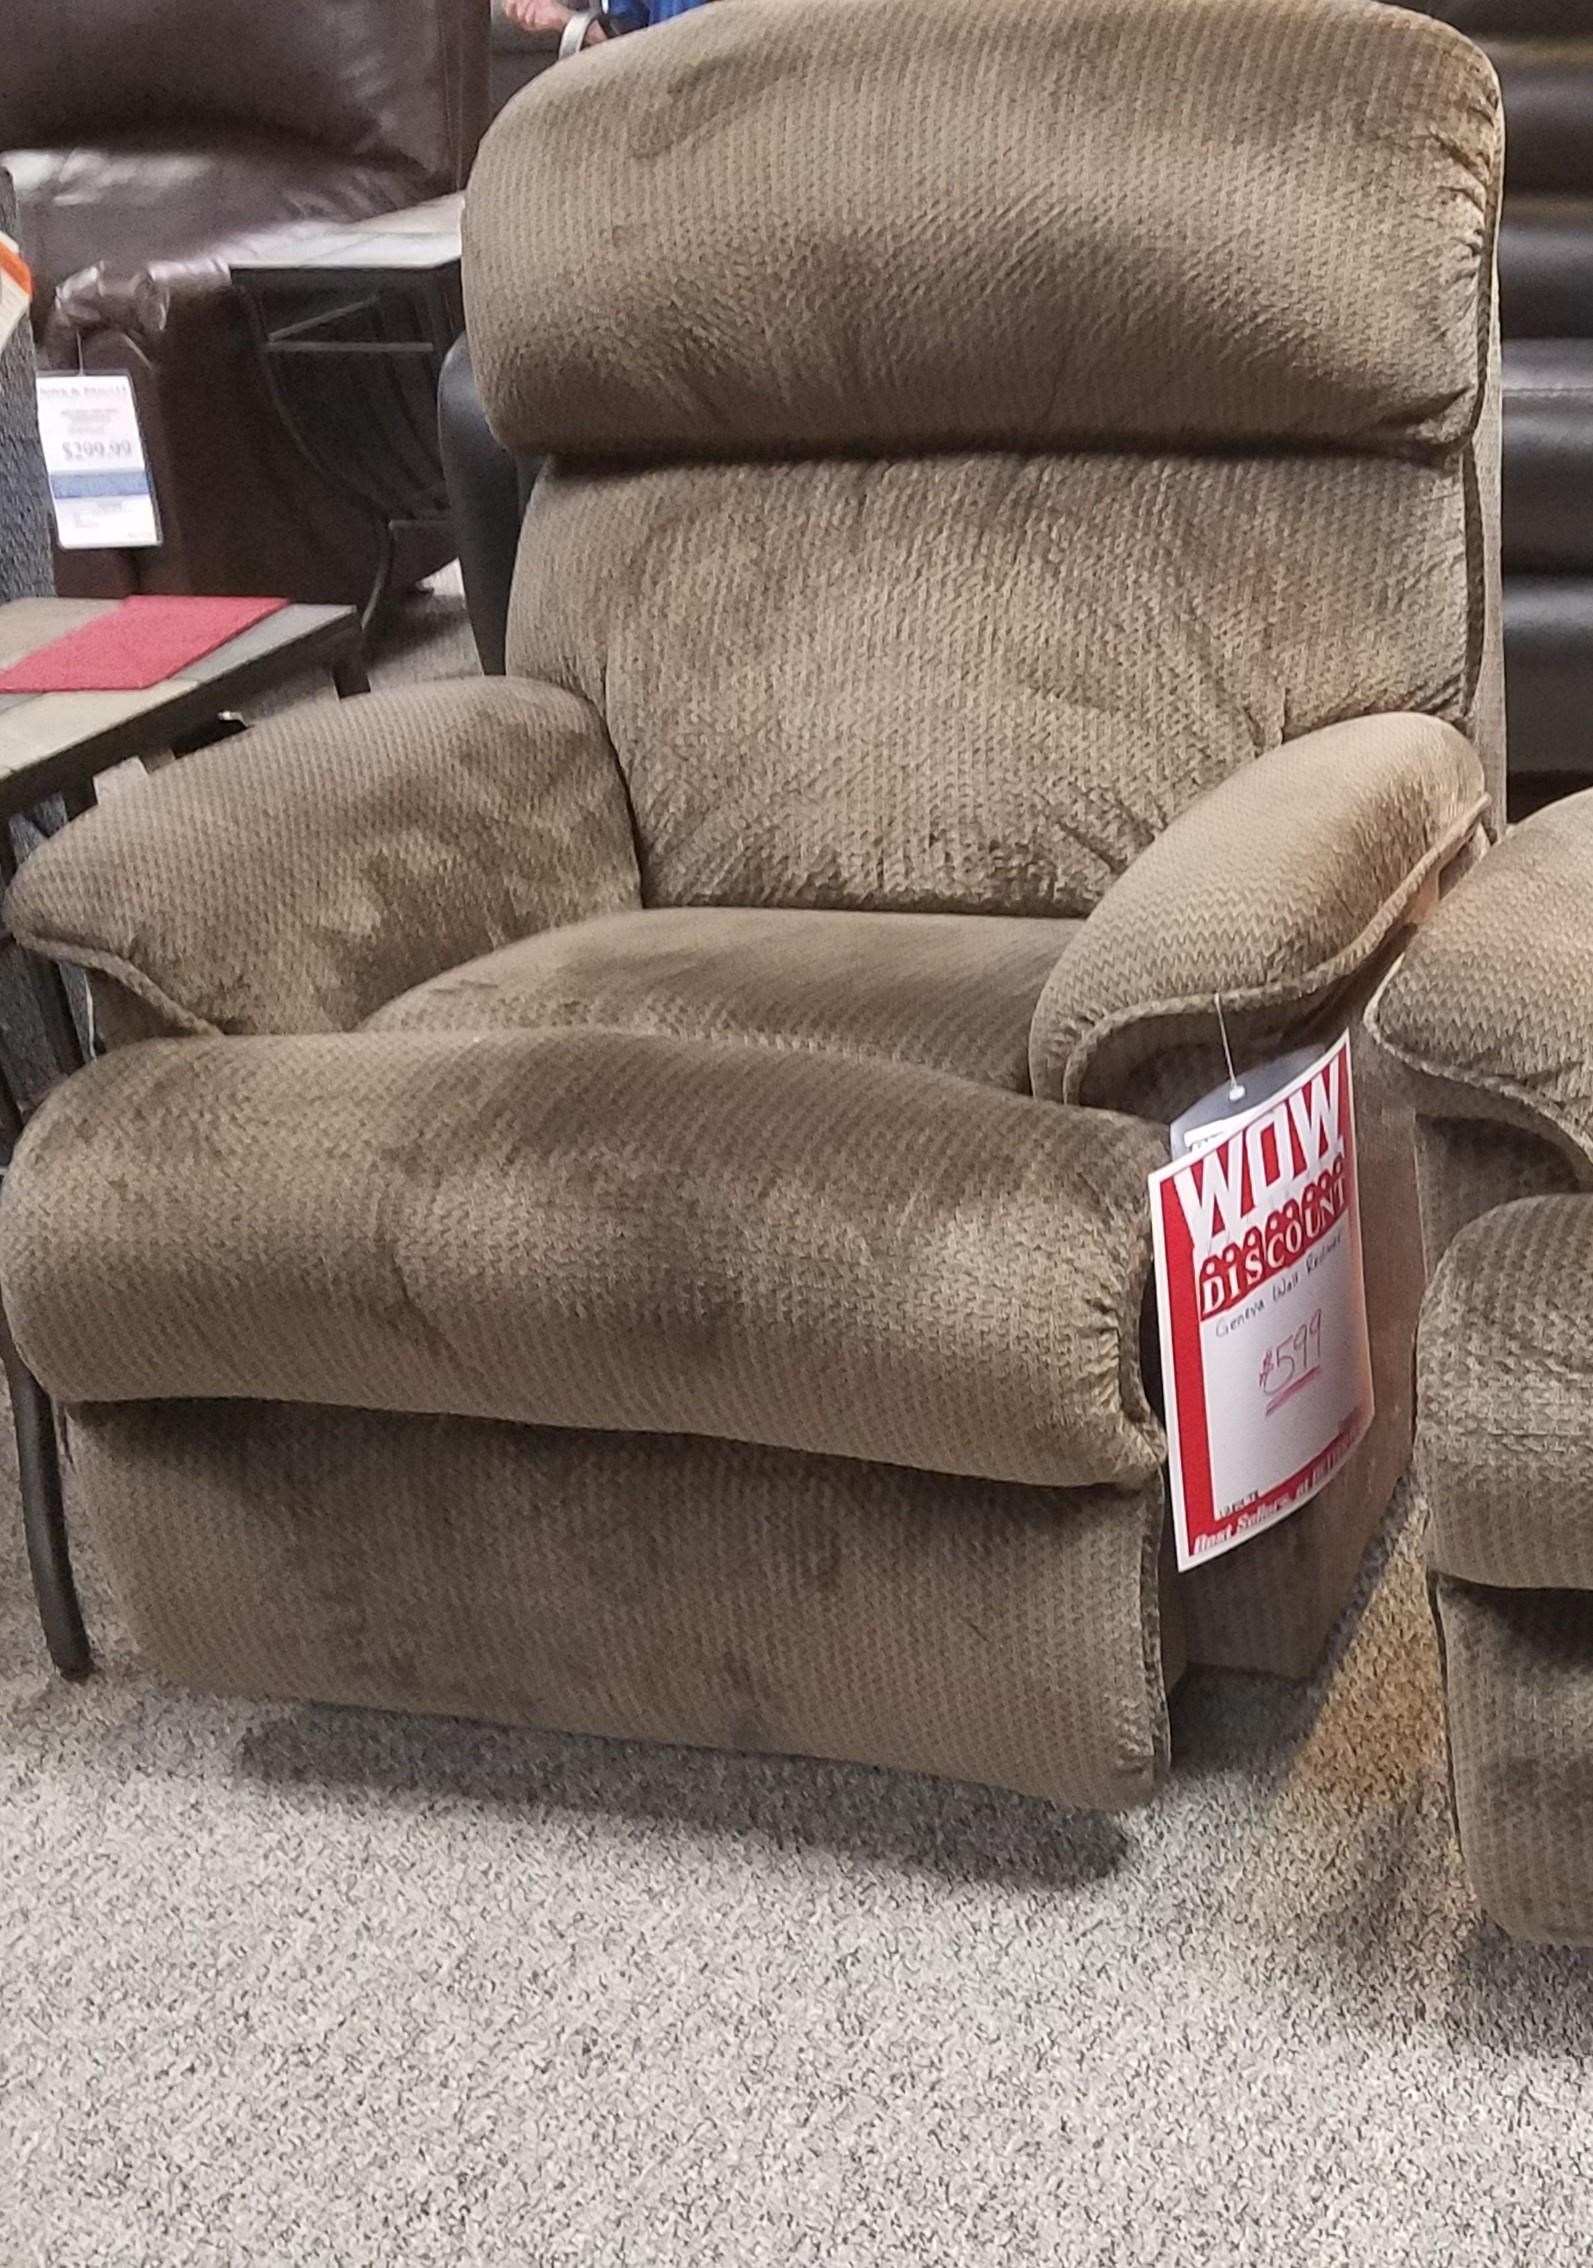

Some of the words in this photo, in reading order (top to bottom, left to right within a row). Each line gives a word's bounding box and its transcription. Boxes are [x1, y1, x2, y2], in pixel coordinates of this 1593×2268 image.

[62, 439, 132, 461] $299.99
[1172, 1055, 1341, 1249] WOW
[1202, 1173, 1345, 1314] DISCOUNT
[1216, 1299, 1265, 1337] Geneva
[1259, 1308, 1322, 1395] $599
